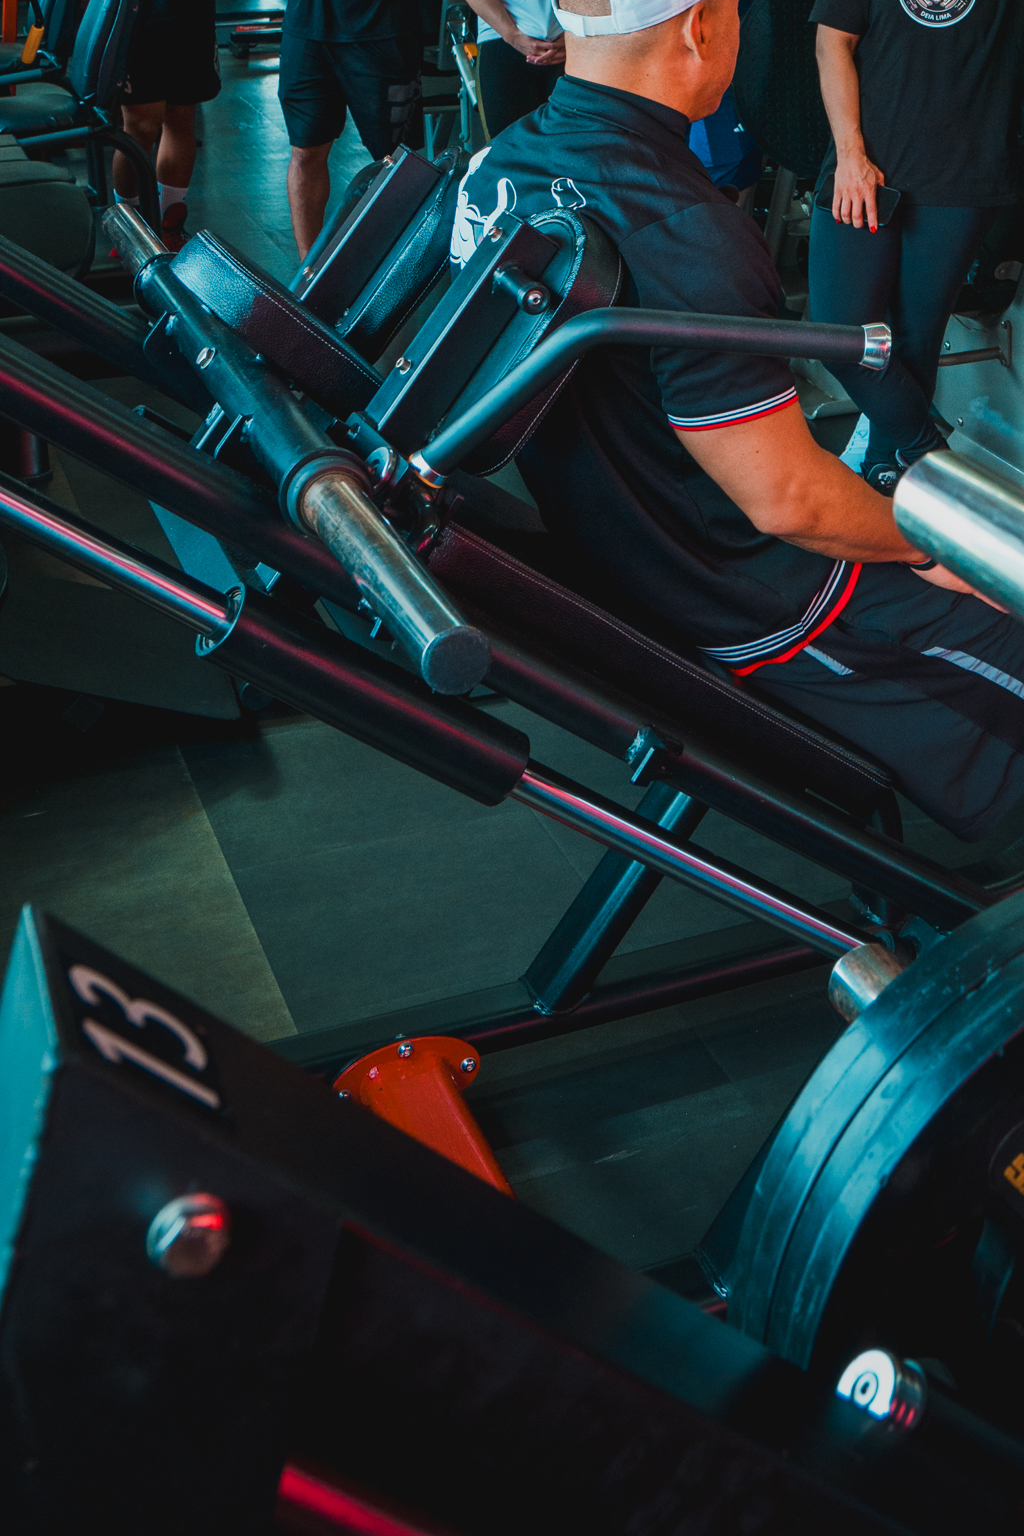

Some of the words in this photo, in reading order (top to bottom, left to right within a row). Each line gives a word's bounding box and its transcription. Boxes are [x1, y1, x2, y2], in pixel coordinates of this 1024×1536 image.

[920, 10, 935, 21] DEIA
[935, 12, 952, 21] LIMA
[69, 964, 221, 1110] 13
